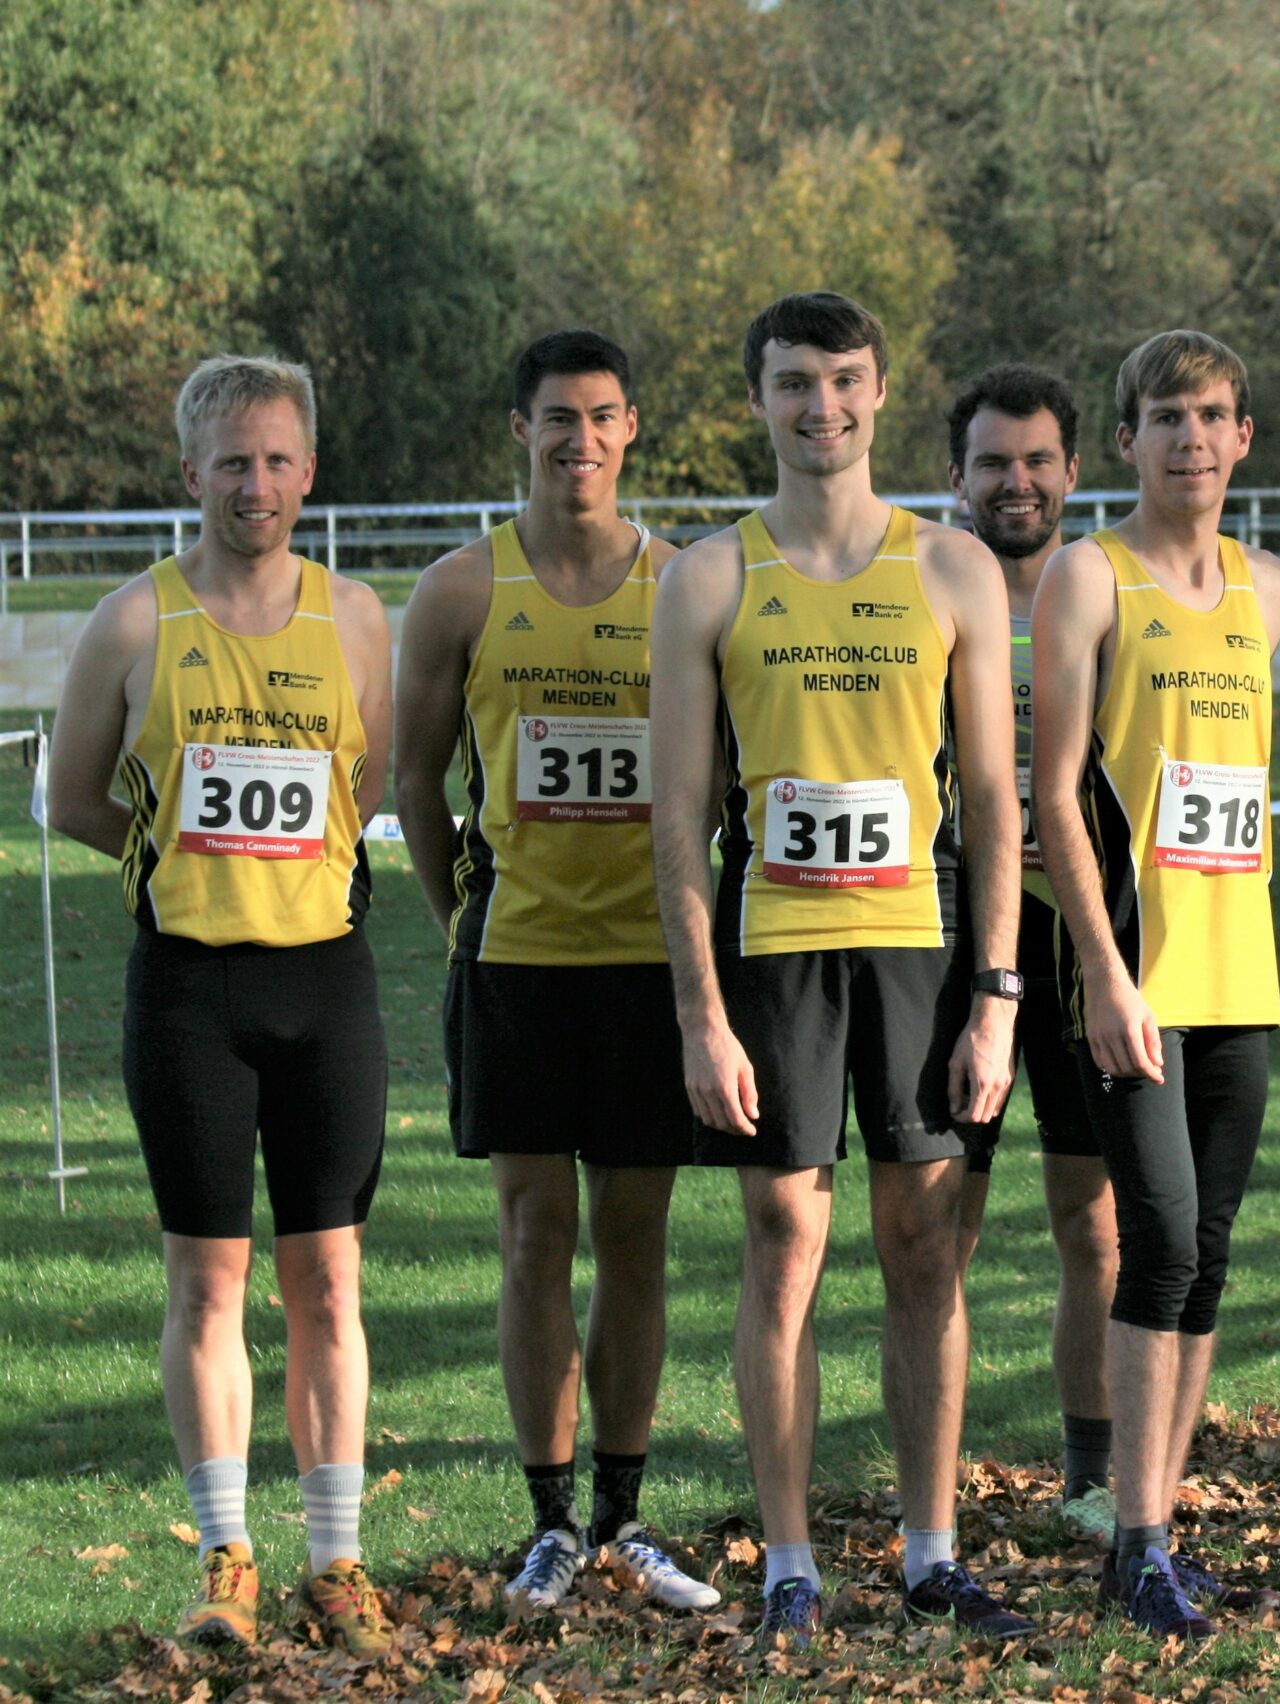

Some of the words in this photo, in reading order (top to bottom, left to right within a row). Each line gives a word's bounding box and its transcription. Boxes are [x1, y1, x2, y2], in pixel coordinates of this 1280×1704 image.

[757, 606, 787, 617] adidas
[874, 603, 910, 612] Mendener
[874, 611, 892, 619] Bank
[1142, 629, 1172, 640] adidas
[763, 645, 918, 666] MARATHON-CLUB
[803, 673, 880, 692] MENDEN
[543, 689, 616, 707] MENDEN
[1190, 699, 1249, 720] MENDEN
[189, 706, 328, 733] MARATHON-CLUB
[538, 746, 638, 798] 313
[197, 776, 313, 833] 309
[549, 806, 584, 818] Philipp
[586, 807, 629, 818] Henseleit
[1178, 793, 1260, 849] 318
[784, 810, 890, 864] 315
[204, 838, 244, 851] Thomas
[246, 840, 302, 855] Camminady
[1165, 853, 1217, 866] Maximilian
[799, 872, 839, 883] Hendrik
[841, 873, 875, 883] Jansen
